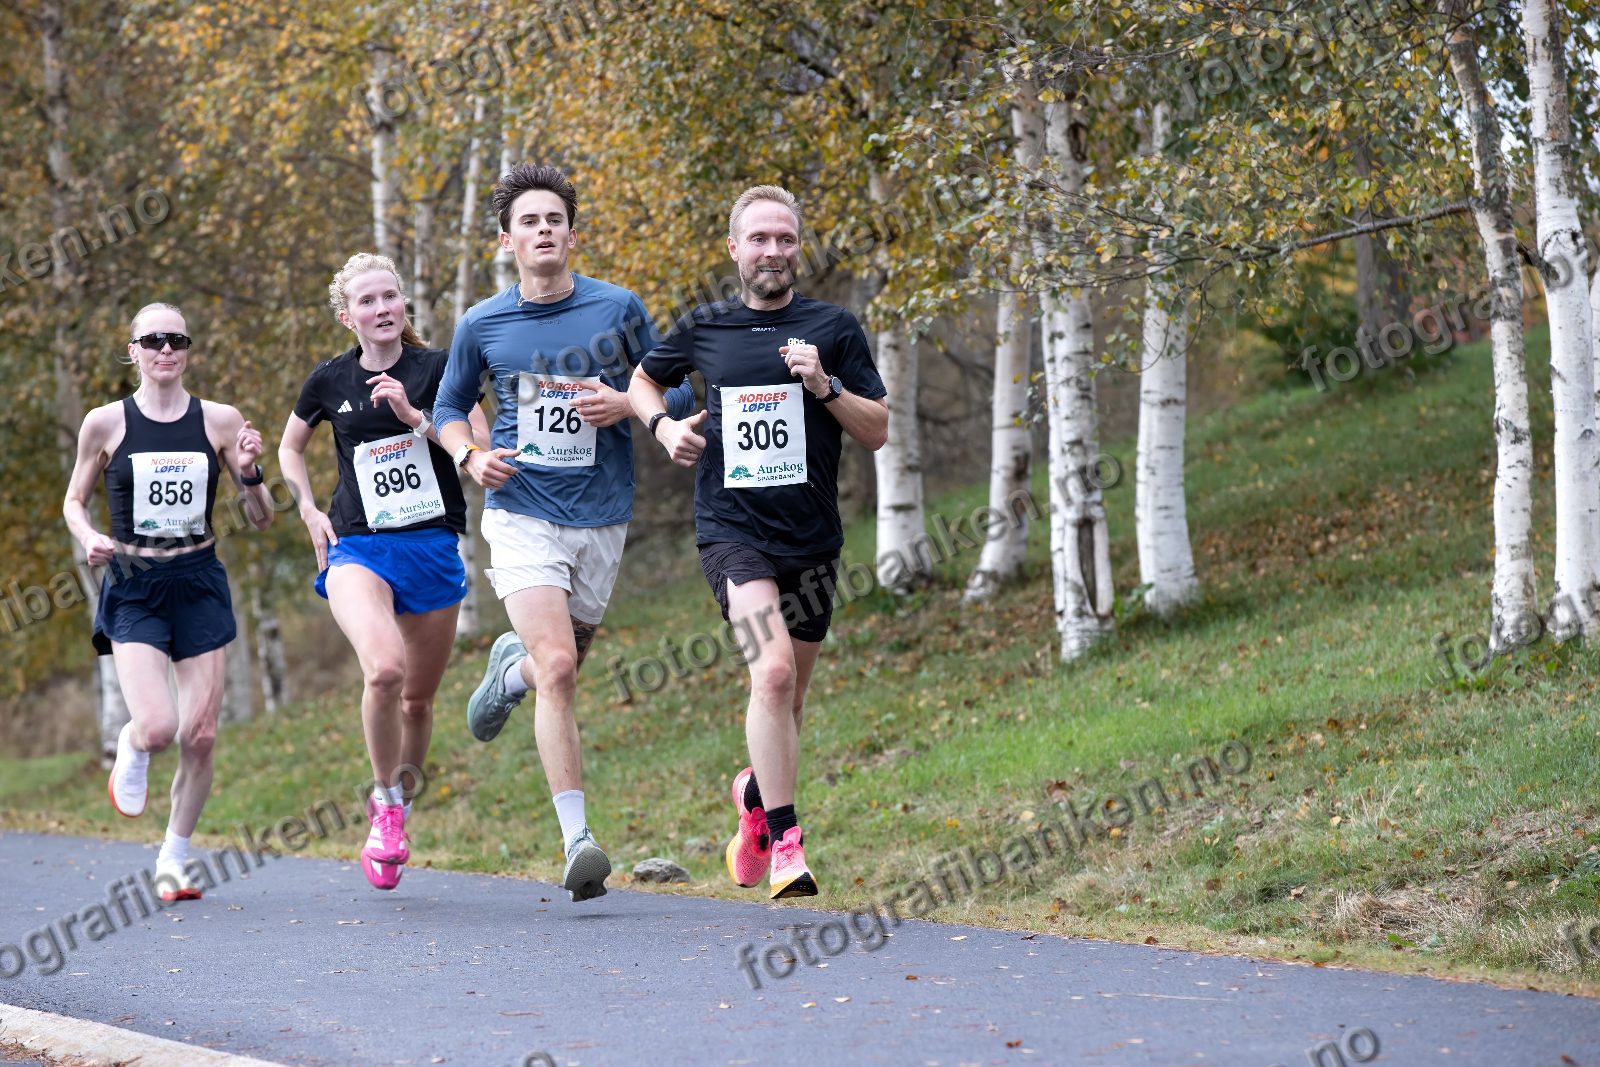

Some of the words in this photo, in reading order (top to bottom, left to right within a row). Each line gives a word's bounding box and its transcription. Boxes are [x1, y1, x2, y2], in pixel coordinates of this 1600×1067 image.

[541, 390, 577, 399] LØPET
[738, 392, 788, 403] NORGES
[742, 402, 780, 412] LØPET
[534, 405, 582, 435] 126
[737, 419, 789, 451] 306
[369, 439, 413, 457] NORGES
[547, 445, 593, 457] Aurskog
[150, 457, 195, 466] NORGES
[375, 448, 408, 464] LØPET
[154, 465, 188, 473] LØPET
[757, 462, 804, 474] Aurskog
[373, 463, 421, 498] 896
[757, 473, 796, 482] SPAREBANK
[148, 480, 193, 506] 858
[399, 499, 441, 515] Aurskog
